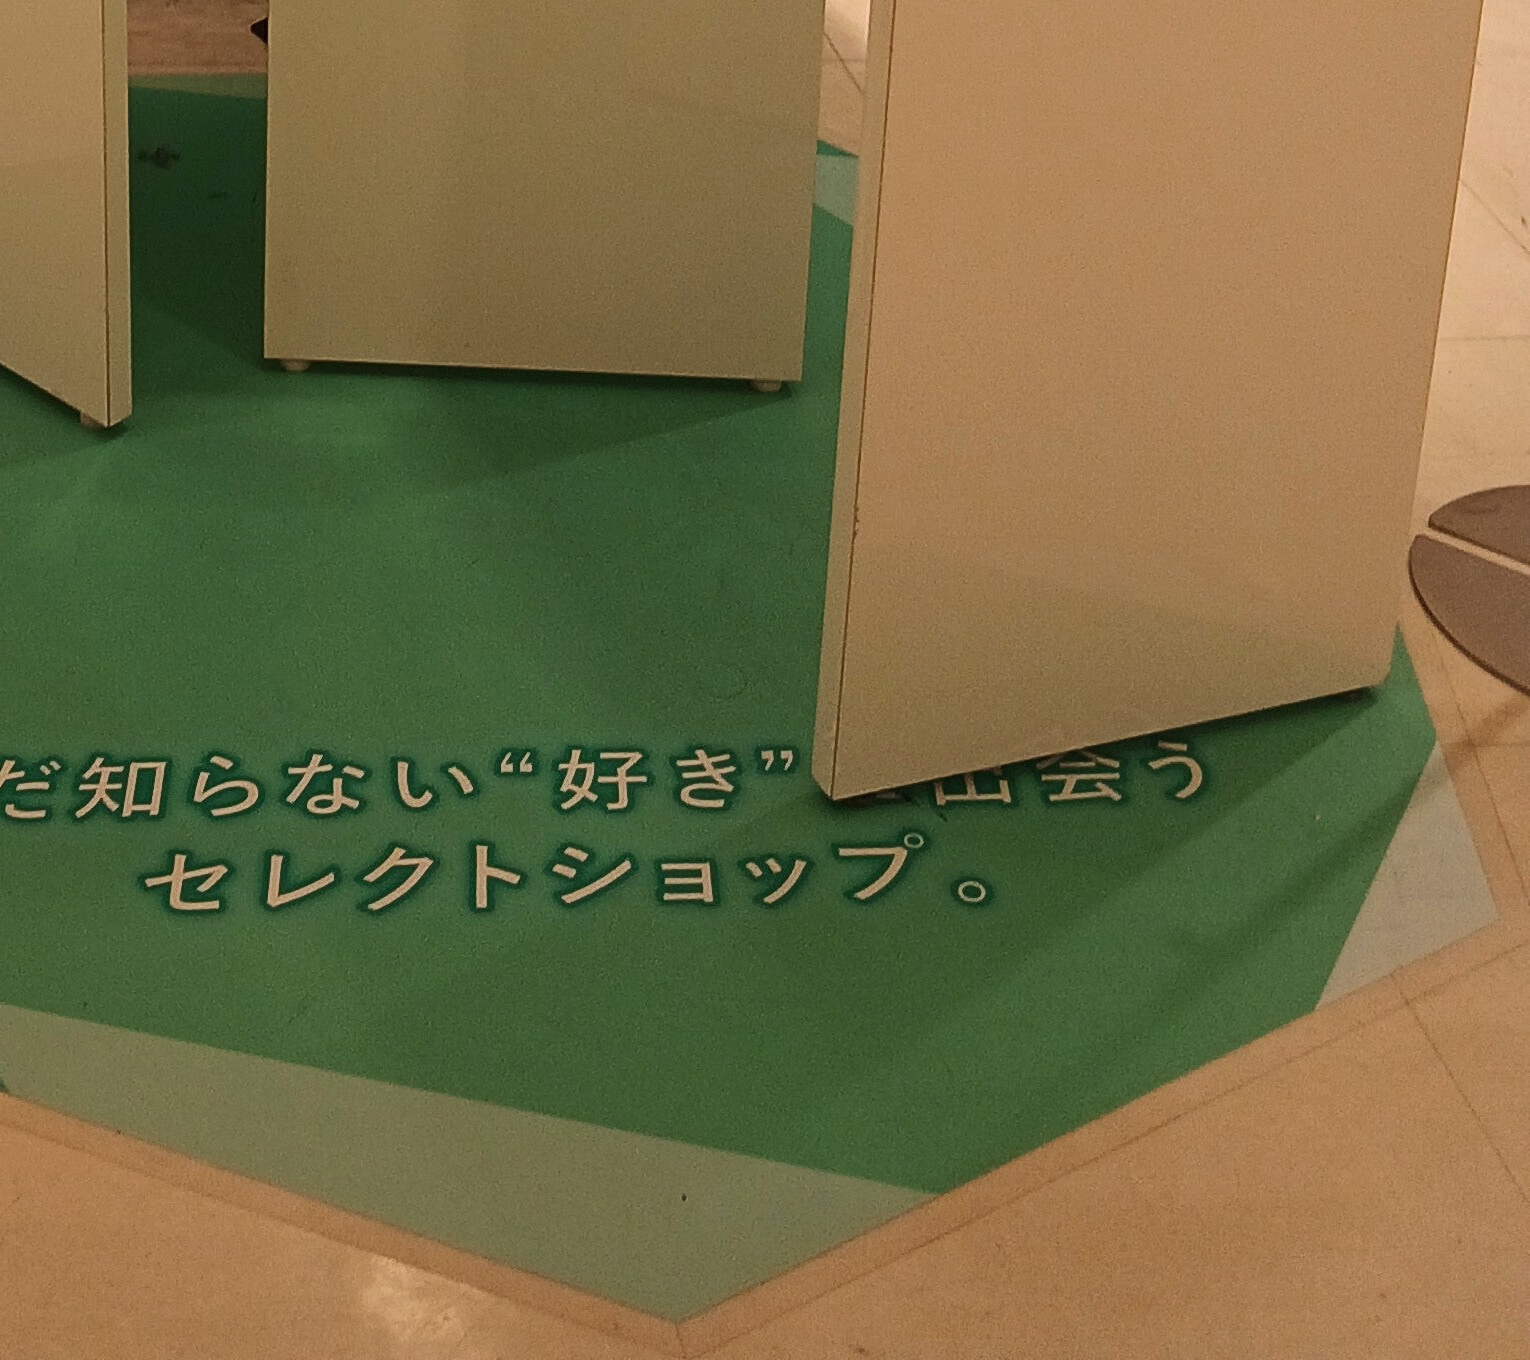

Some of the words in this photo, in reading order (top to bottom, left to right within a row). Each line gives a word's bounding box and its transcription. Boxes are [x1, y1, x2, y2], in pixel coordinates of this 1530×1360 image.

[144, 831, 988, 912] セレクトショップ。
